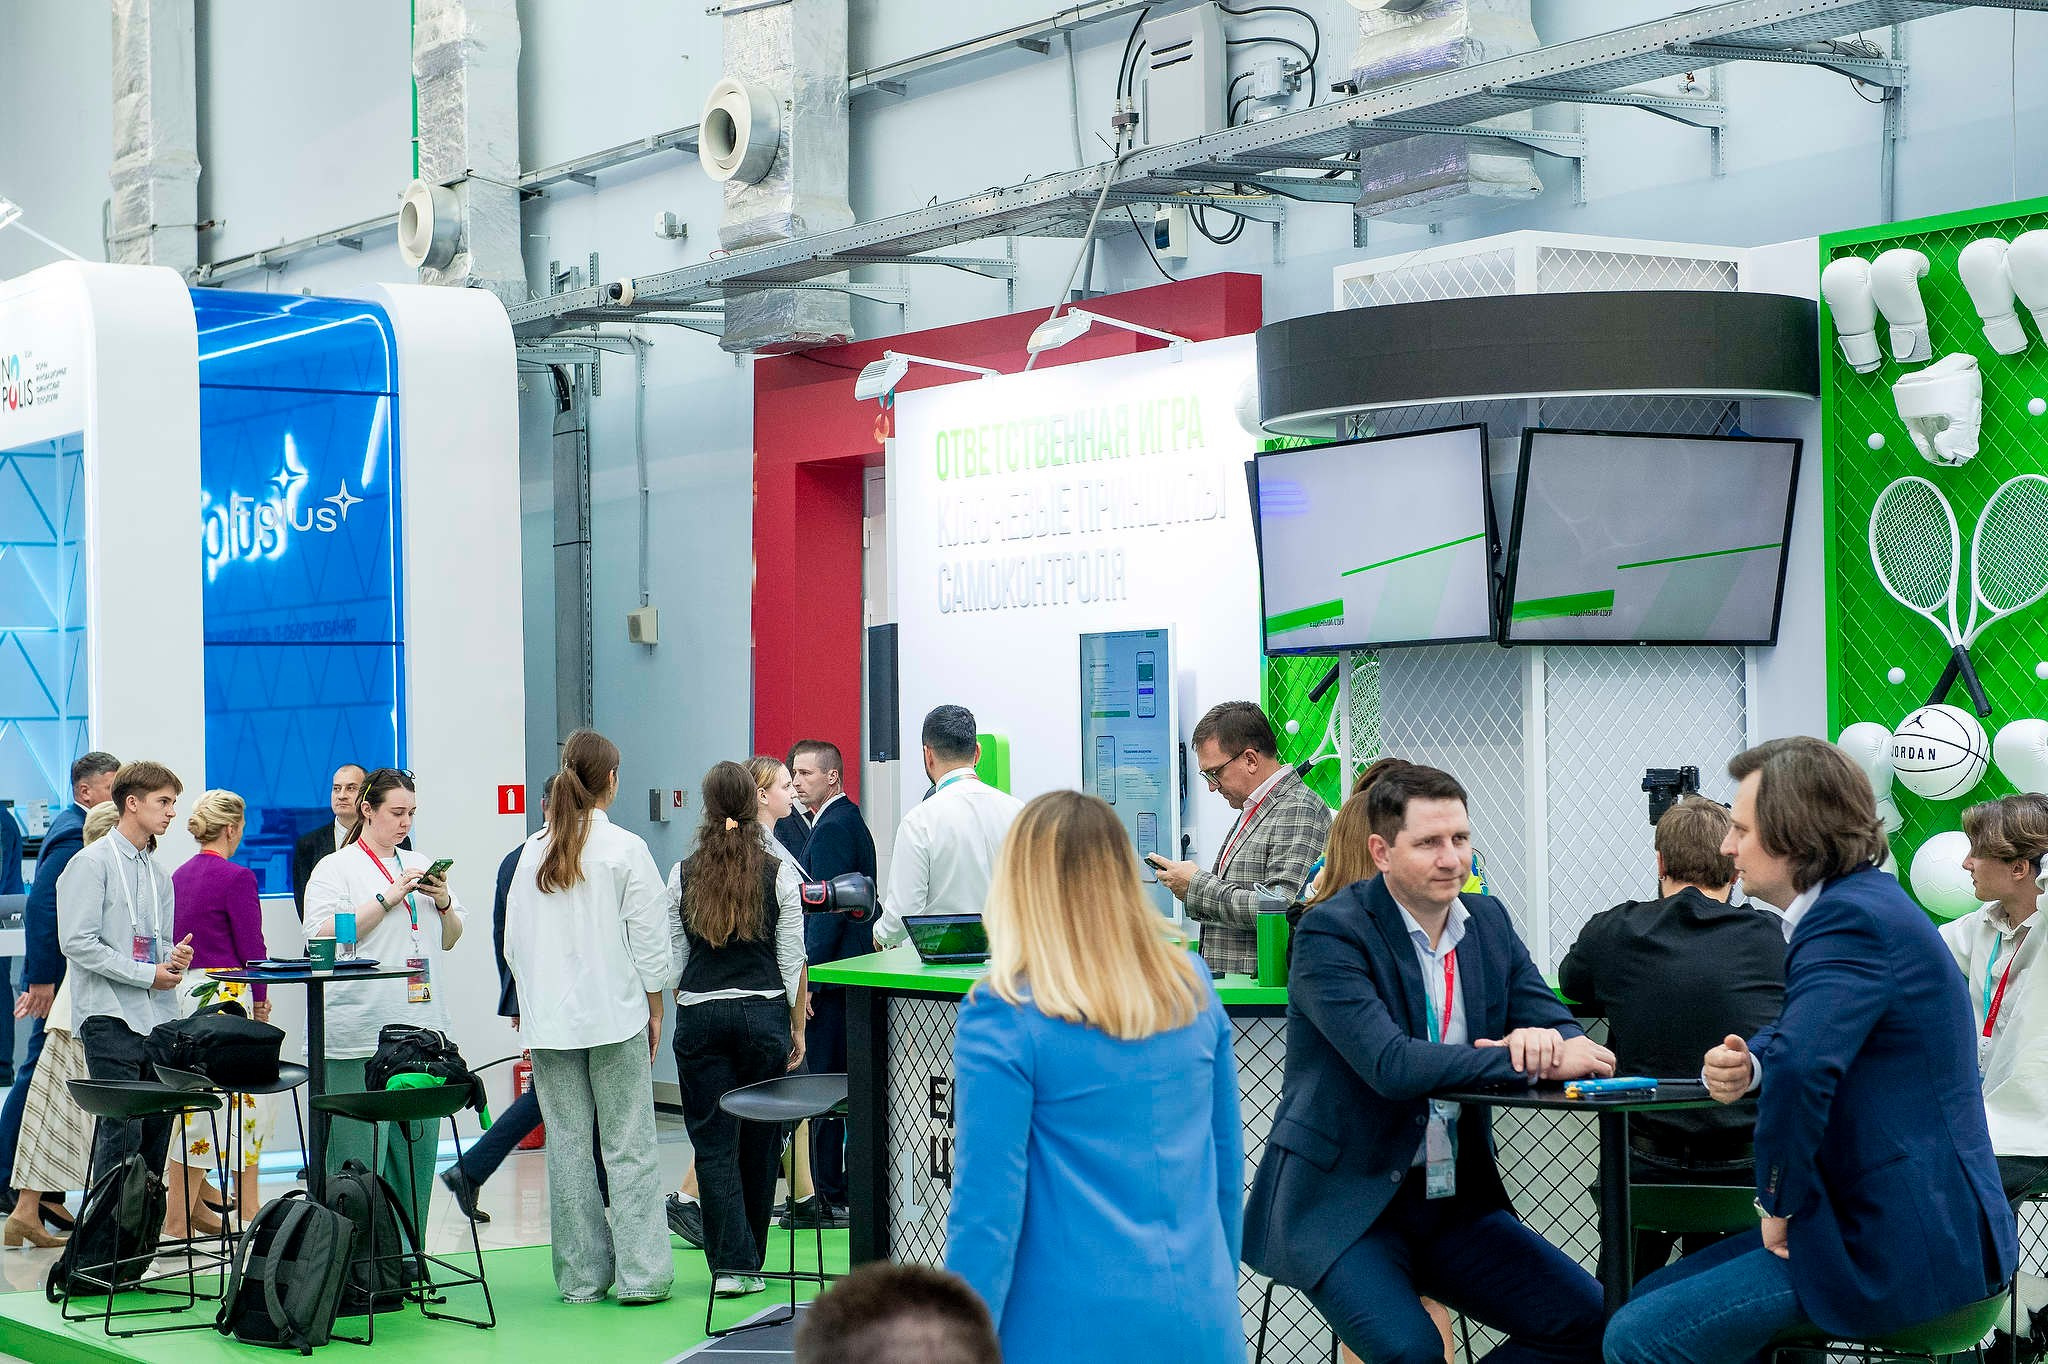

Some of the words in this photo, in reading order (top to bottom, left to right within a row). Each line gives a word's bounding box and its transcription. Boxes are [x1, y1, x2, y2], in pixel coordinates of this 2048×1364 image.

[936, 404, 1130, 481] ОТВЕТСТВЕННАЯ
[1136, 394, 1206, 456] ИГРА
[936, 549, 1128, 614] САМОКОНТРОЛЯ
[1891, 745, 1936, 761] JORDAN
